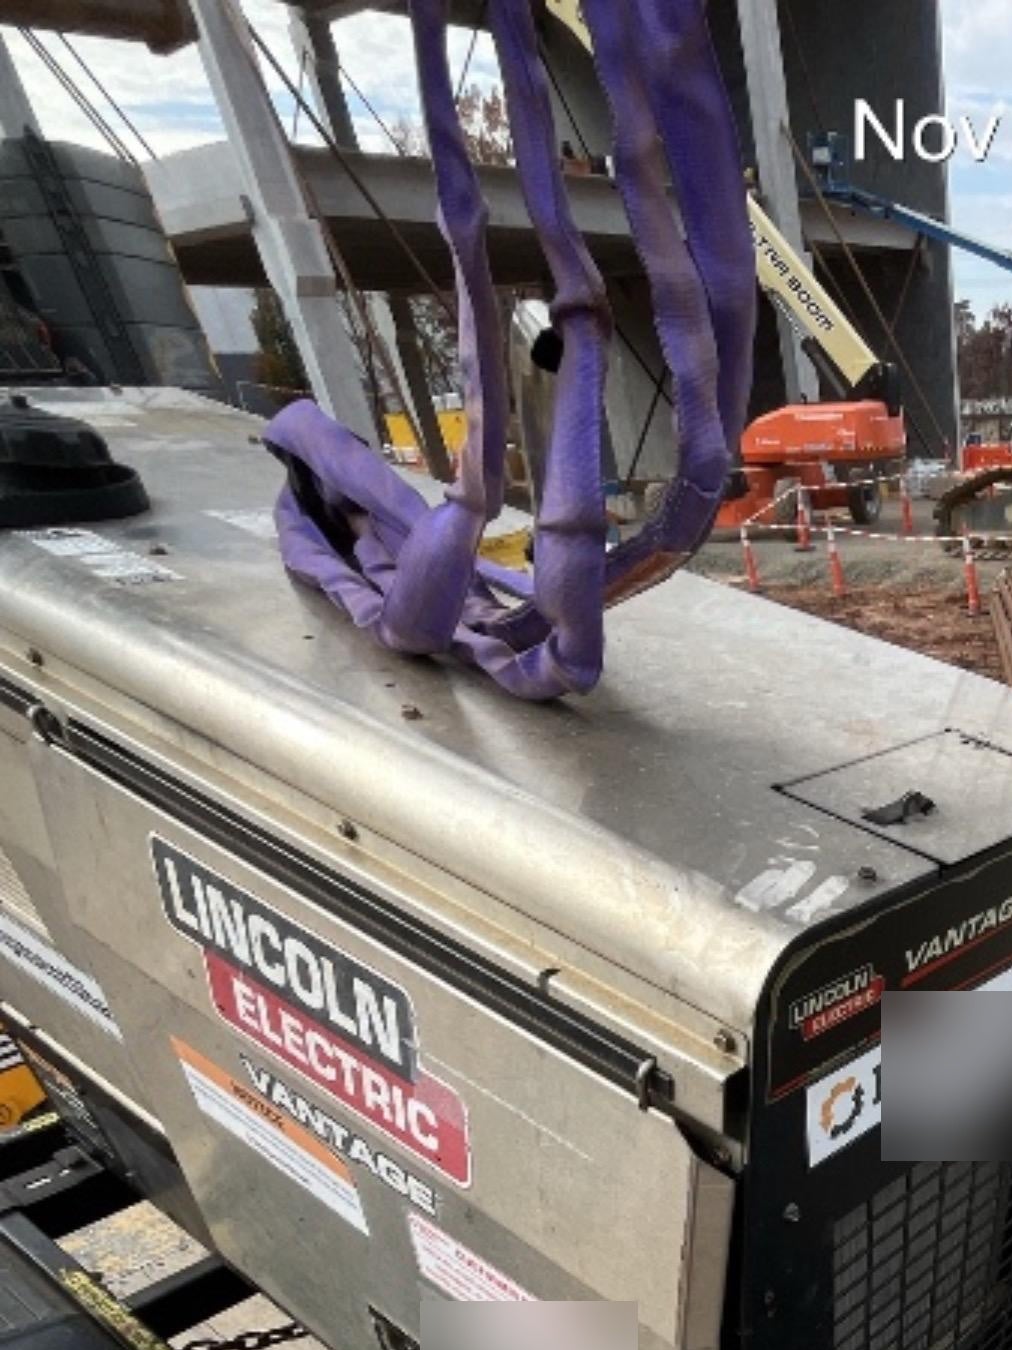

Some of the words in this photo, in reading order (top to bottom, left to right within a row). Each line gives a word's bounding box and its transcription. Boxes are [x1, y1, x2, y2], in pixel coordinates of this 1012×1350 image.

[163, 856, 402, 1067] LINCOLN
[794, 970, 869, 1024] LINCOLN
[231, 976, 439, 1151] ELECTRIC
[240, 1052, 437, 1216] VANTAGE
